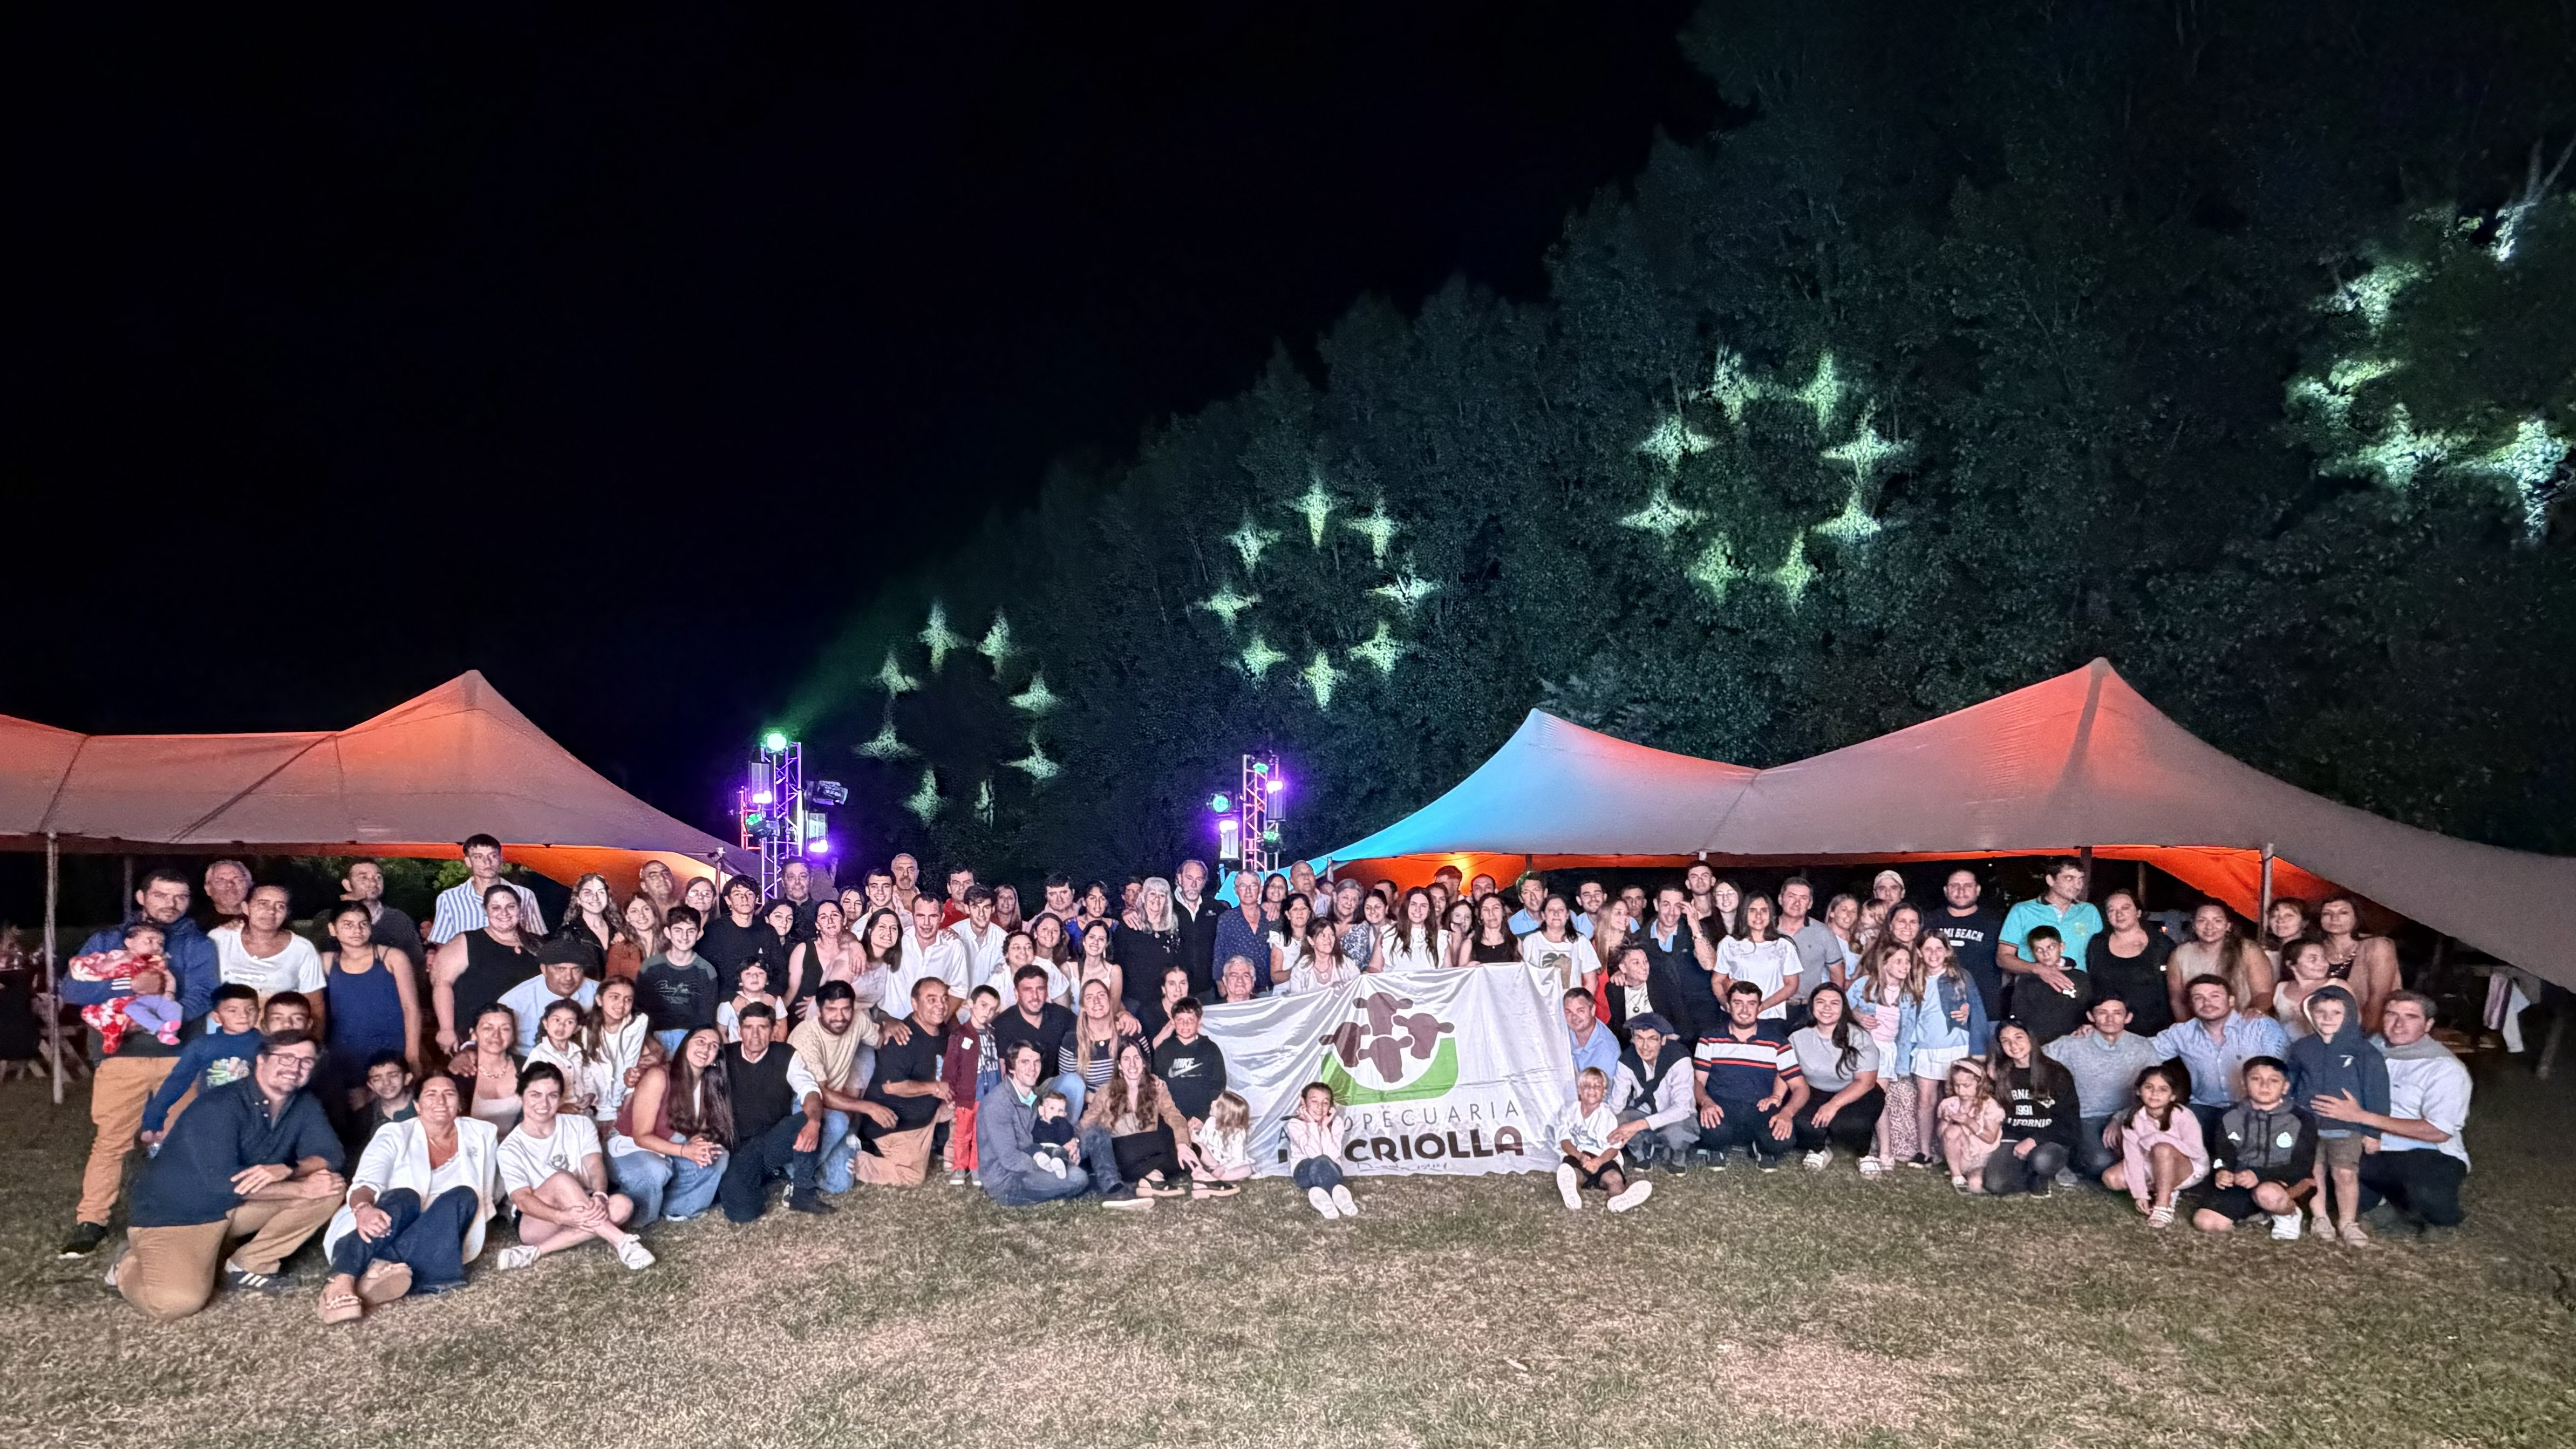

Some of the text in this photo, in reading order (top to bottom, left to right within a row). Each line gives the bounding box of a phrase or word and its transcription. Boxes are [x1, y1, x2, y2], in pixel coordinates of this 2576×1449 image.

[1954, 928, 1984, 942] BEACH
[1173, 1058, 1195, 1069] NIKE
[2015, 1105, 2033, 1115] 1991
[1278, 1099, 1518, 1144] AOPECUARIA
[2007, 1117, 2052, 1128] LIFORNIA
[1344, 1126, 1524, 1163] CRIOLLA
